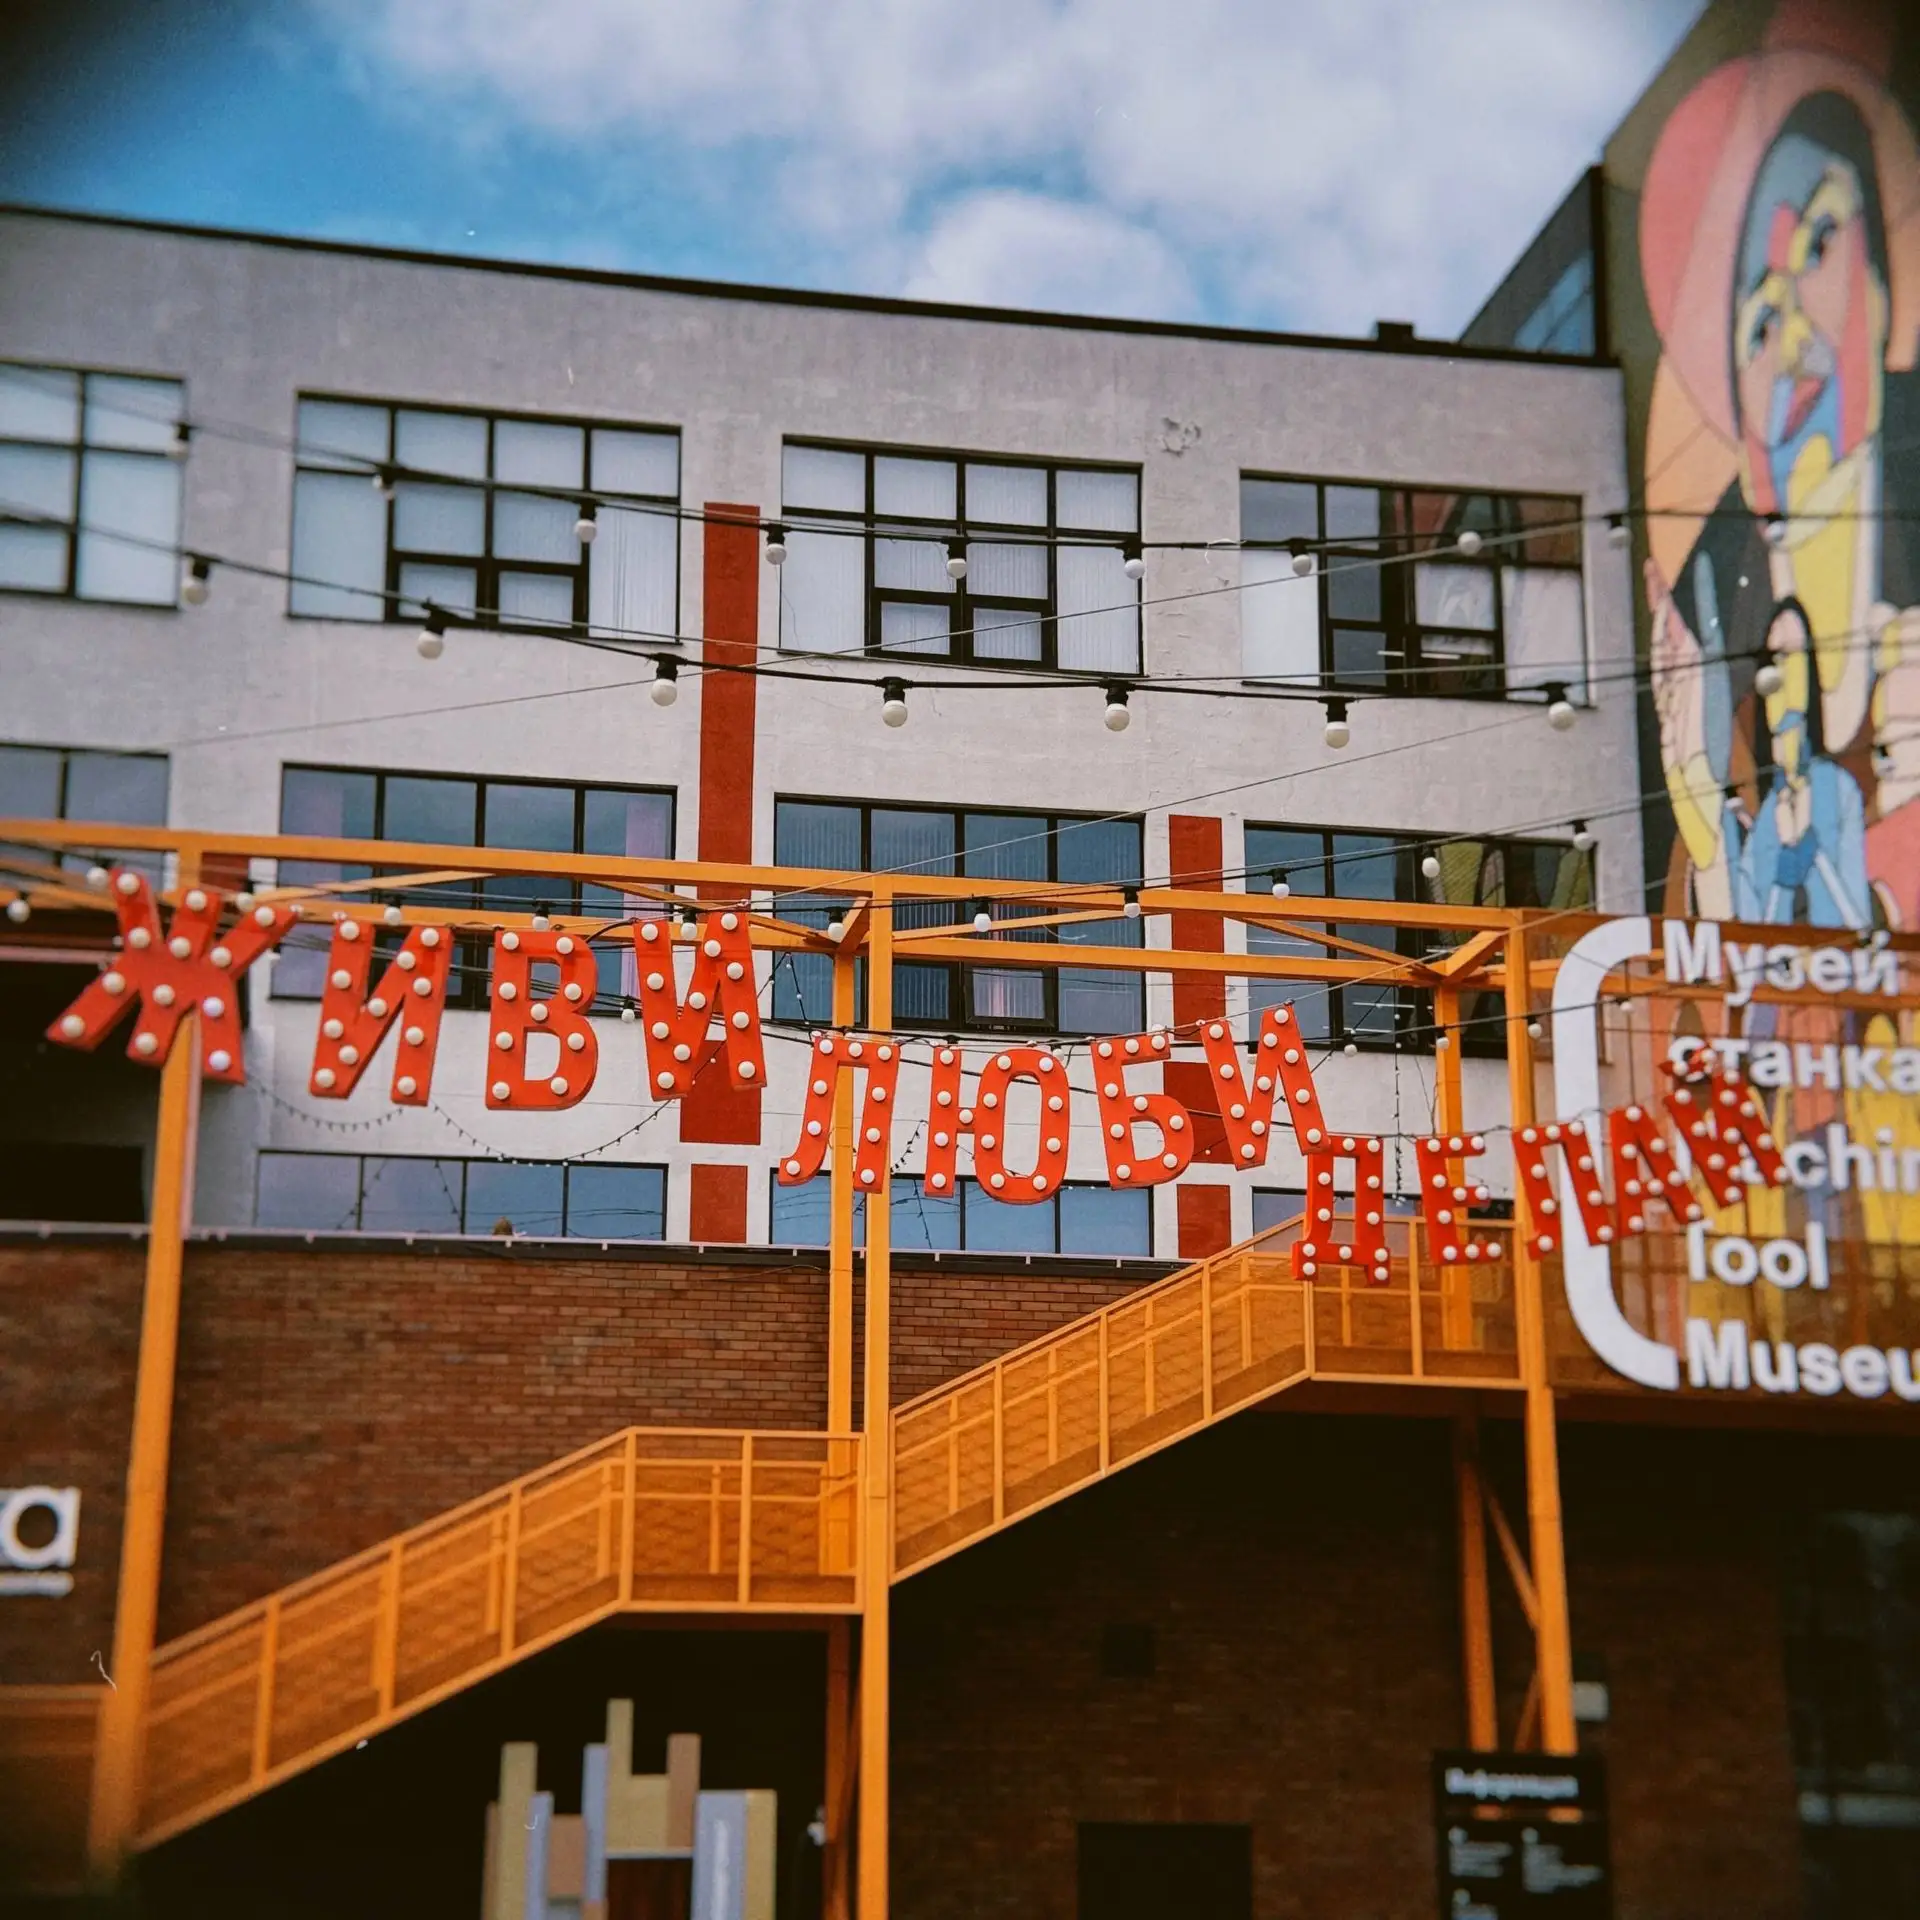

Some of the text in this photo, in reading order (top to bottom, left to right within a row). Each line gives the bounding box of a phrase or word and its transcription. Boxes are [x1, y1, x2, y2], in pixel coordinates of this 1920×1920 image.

[46, 867, 767, 1111] ЖИВИ
[1662, 918, 1900, 1007] Музей
[778, 1003, 1330, 1205] ЛЮБИ
[1684, 1219, 1830, 1291] Tool
